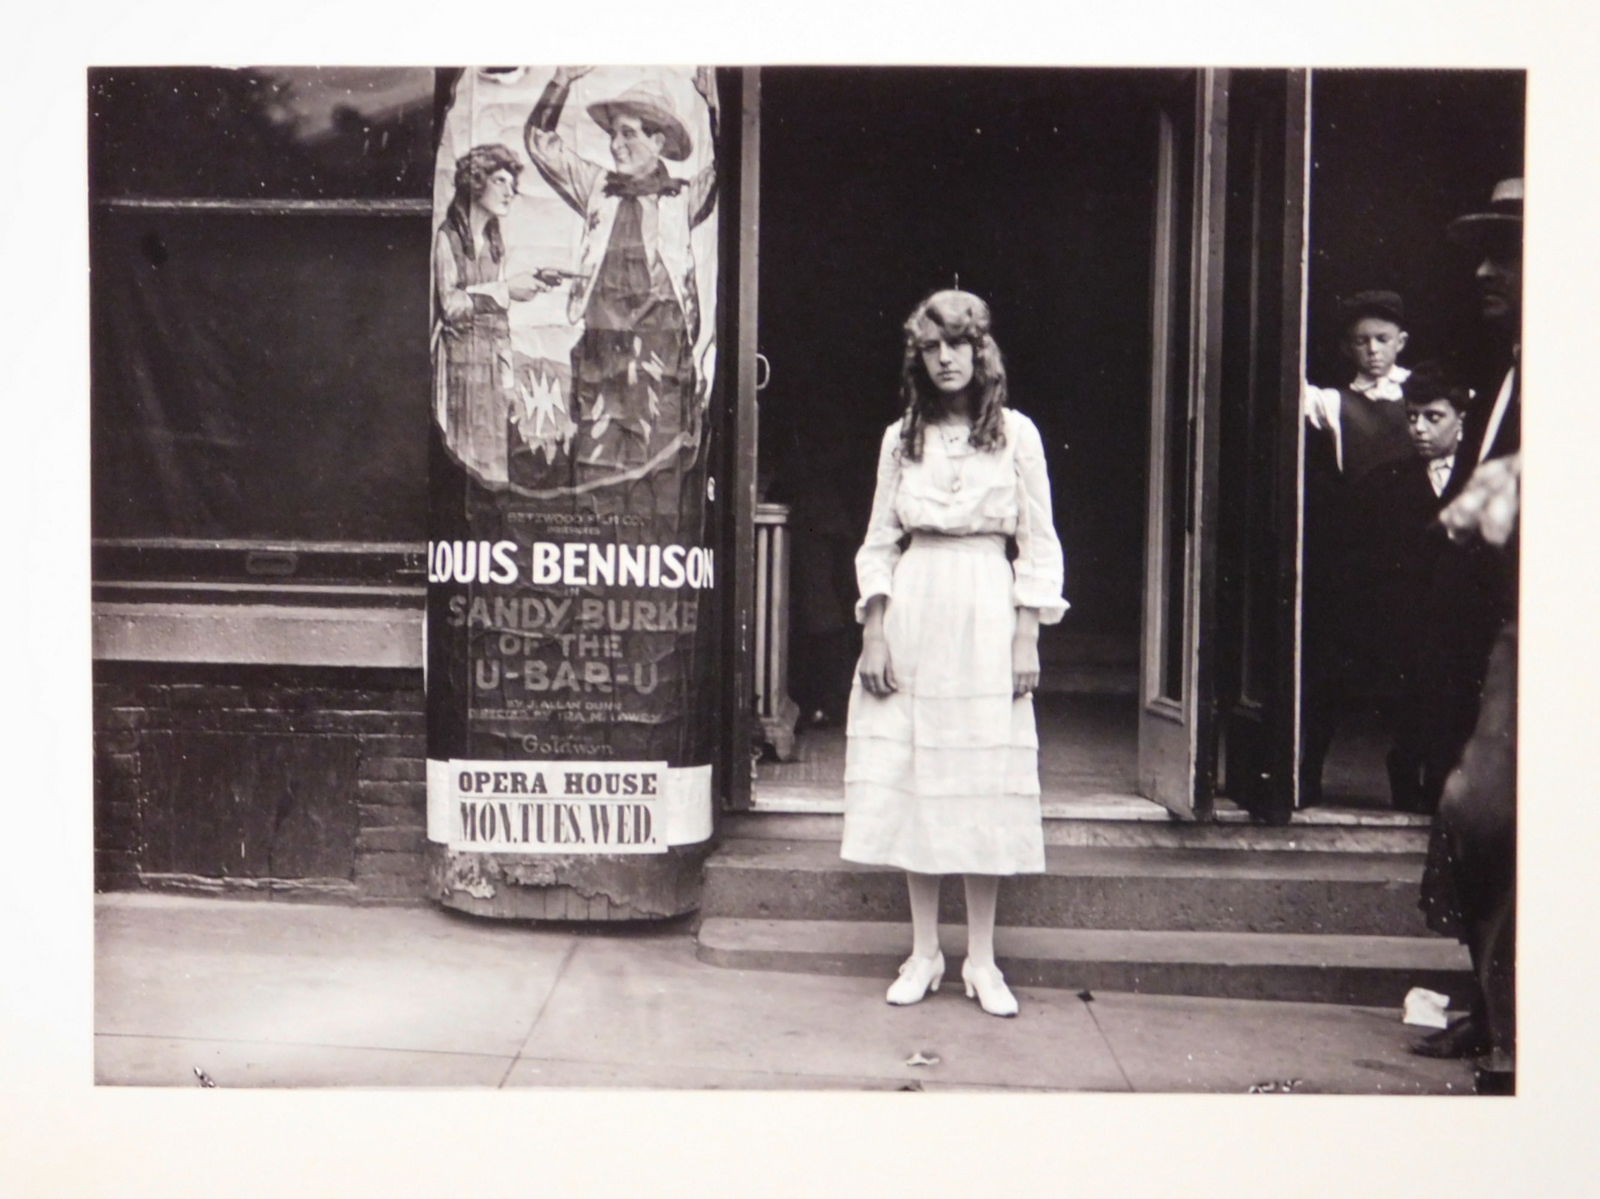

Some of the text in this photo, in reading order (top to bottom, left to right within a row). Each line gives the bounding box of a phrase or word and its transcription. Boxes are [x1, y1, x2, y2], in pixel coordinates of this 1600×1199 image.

[428, 540, 714, 589] LOUIS BENNISON
[448, 596, 697, 632] SANDY BURKE
[500, 634, 623, 659] OF THE
[476, 659, 658, 694] U-BAR-U
[522, 734, 614, 755] Goldwyn
[458, 771, 657, 795] OPERA HOUSE
